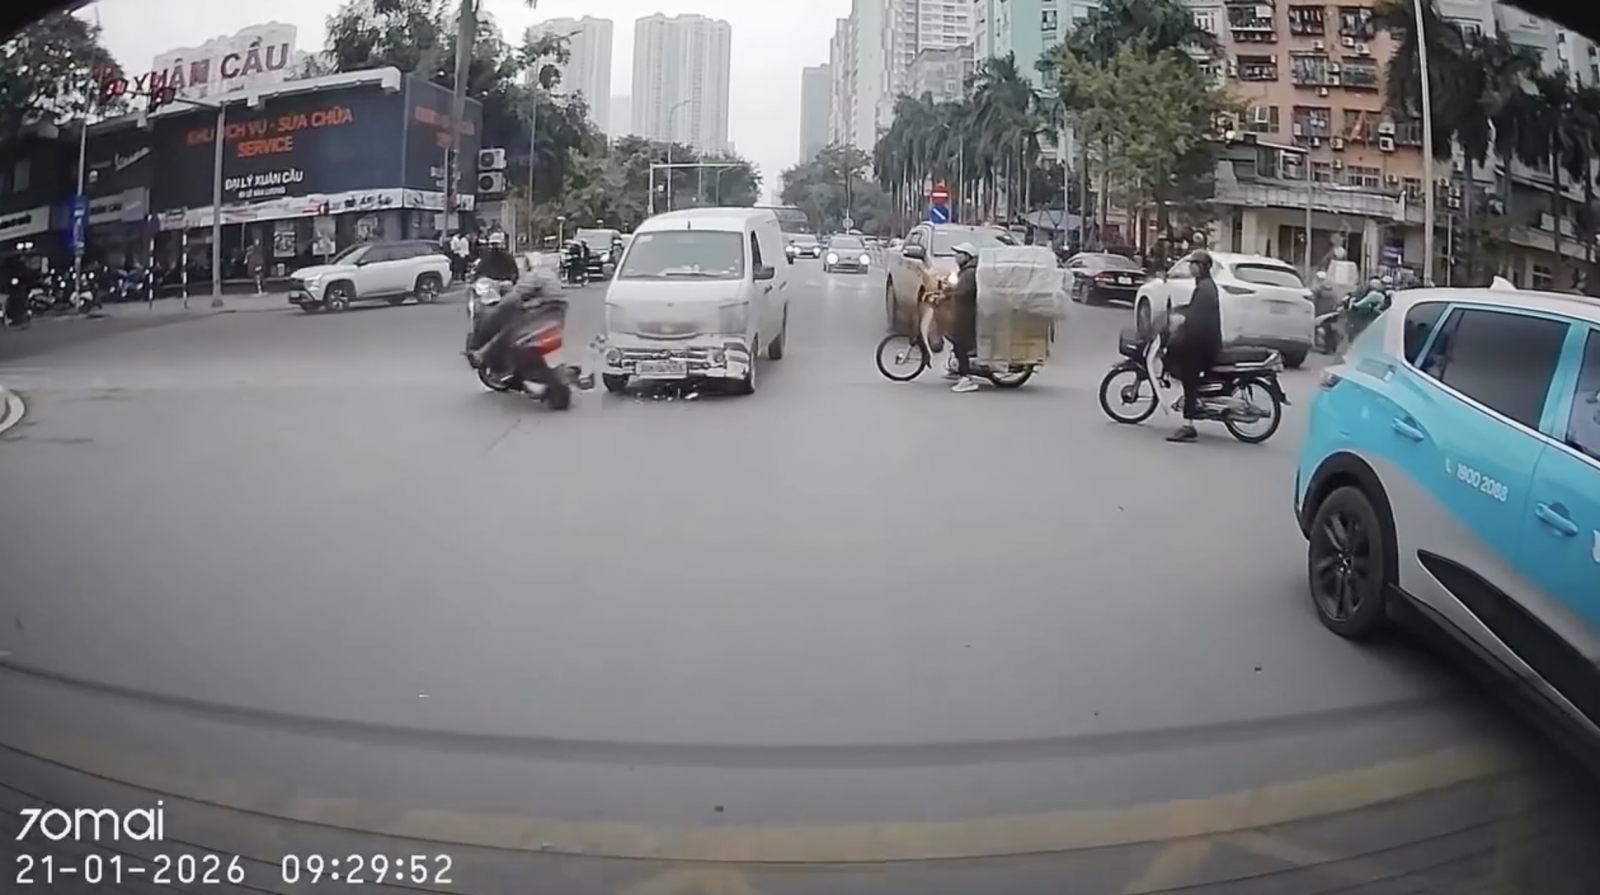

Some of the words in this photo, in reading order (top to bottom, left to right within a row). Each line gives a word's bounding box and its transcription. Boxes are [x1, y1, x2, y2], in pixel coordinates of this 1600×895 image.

[220, 36, 288, 80] CẦU
[237, 136, 294, 157] SERVICE
[1456, 463, 1481, 488] 1900
[1480, 476, 1509, 502] 2088
